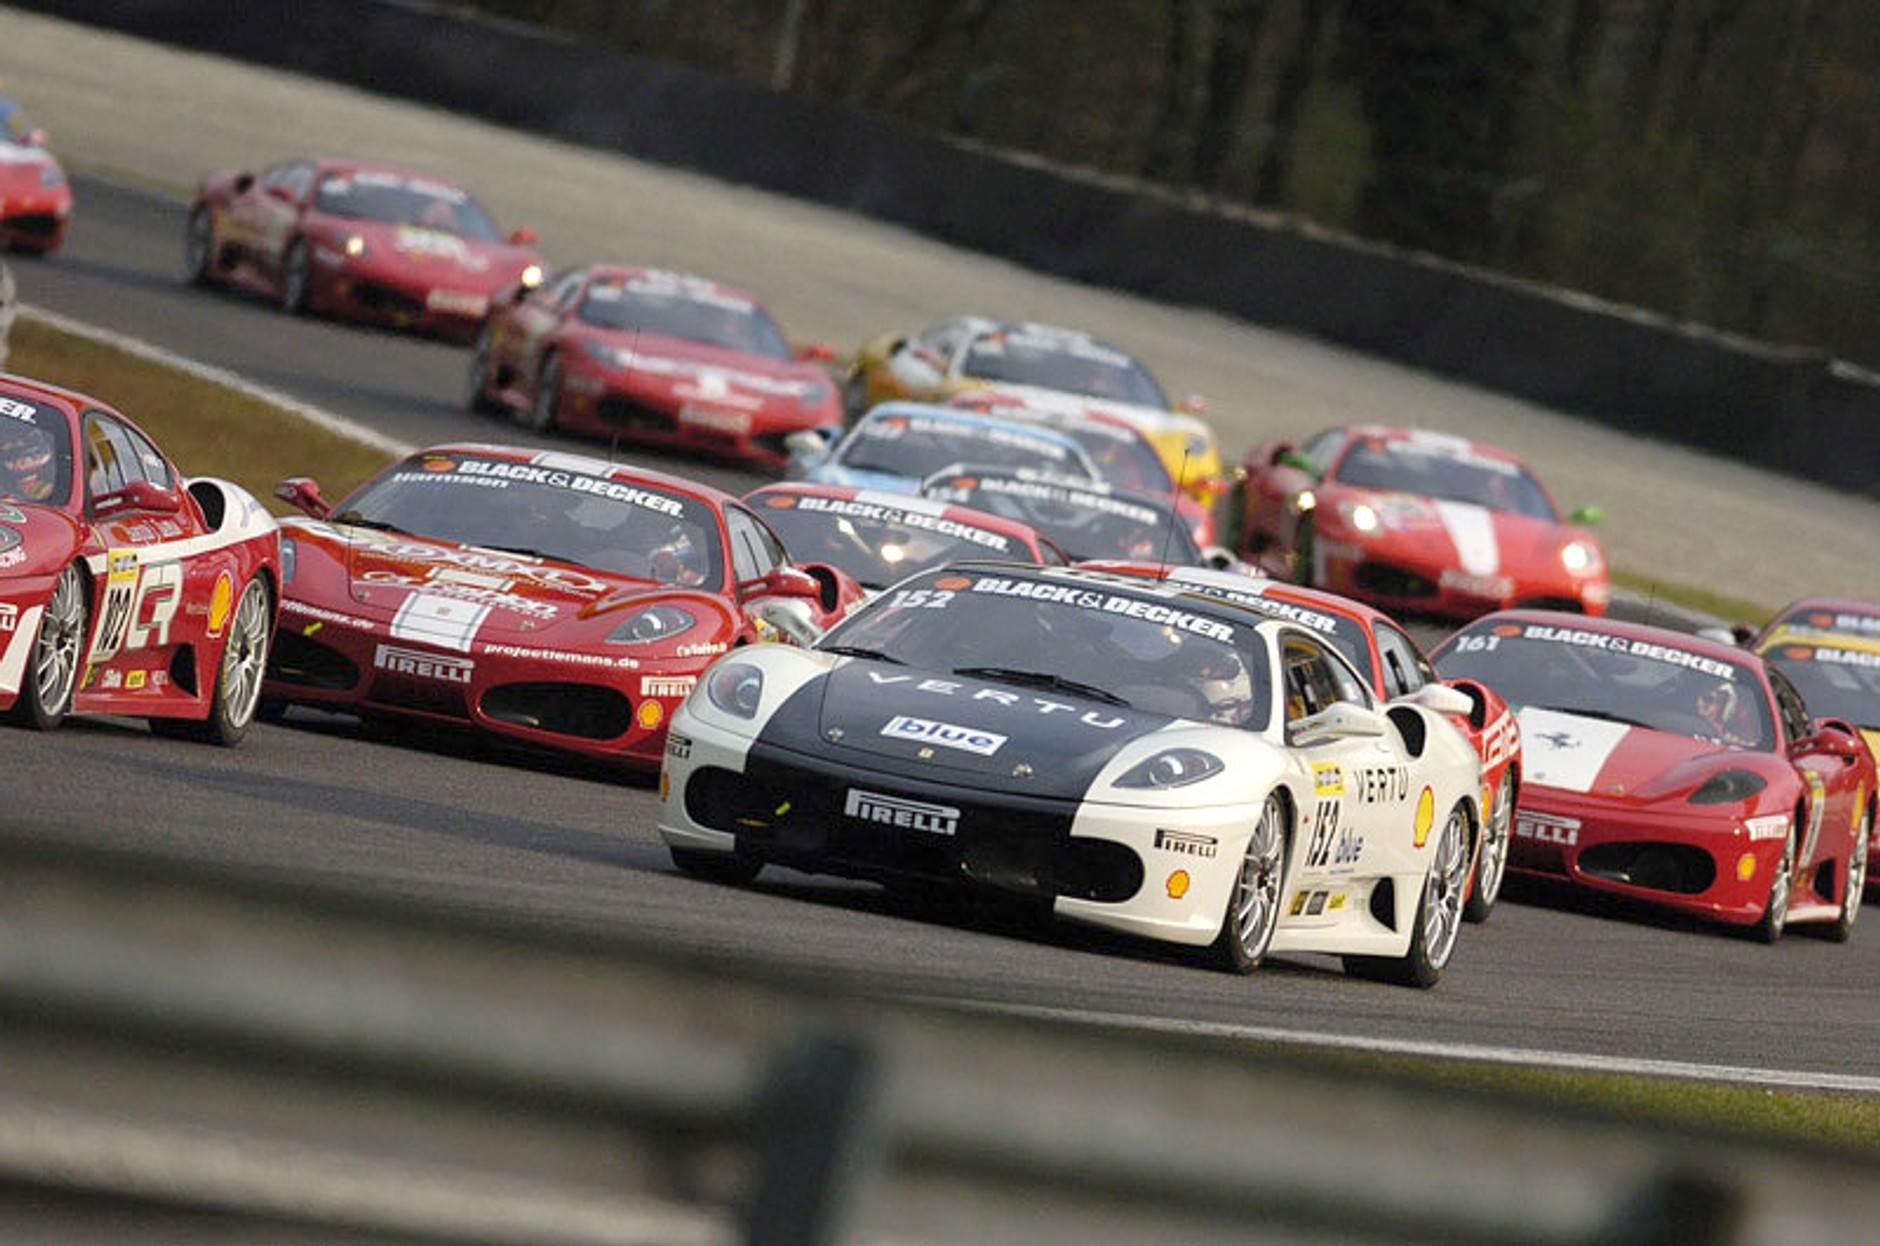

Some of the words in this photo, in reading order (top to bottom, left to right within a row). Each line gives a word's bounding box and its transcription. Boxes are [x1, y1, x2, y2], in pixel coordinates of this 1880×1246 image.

[890, 588, 956, 609] 152
[972, 576, 1236, 644] BLACK&DECKER
[374, 642, 476, 684] PIRELLI
[1456, 635, 1500, 653] 161
[1524, 625, 1737, 680] BLACK&DECKER
[867, 671, 1126, 729] VERTU
[898, 720, 994, 748] blue
[1353, 766, 1409, 804] VERTU
[844, 788, 962, 836] PIRELLI
[1154, 827, 1219, 858] PIRELLI
